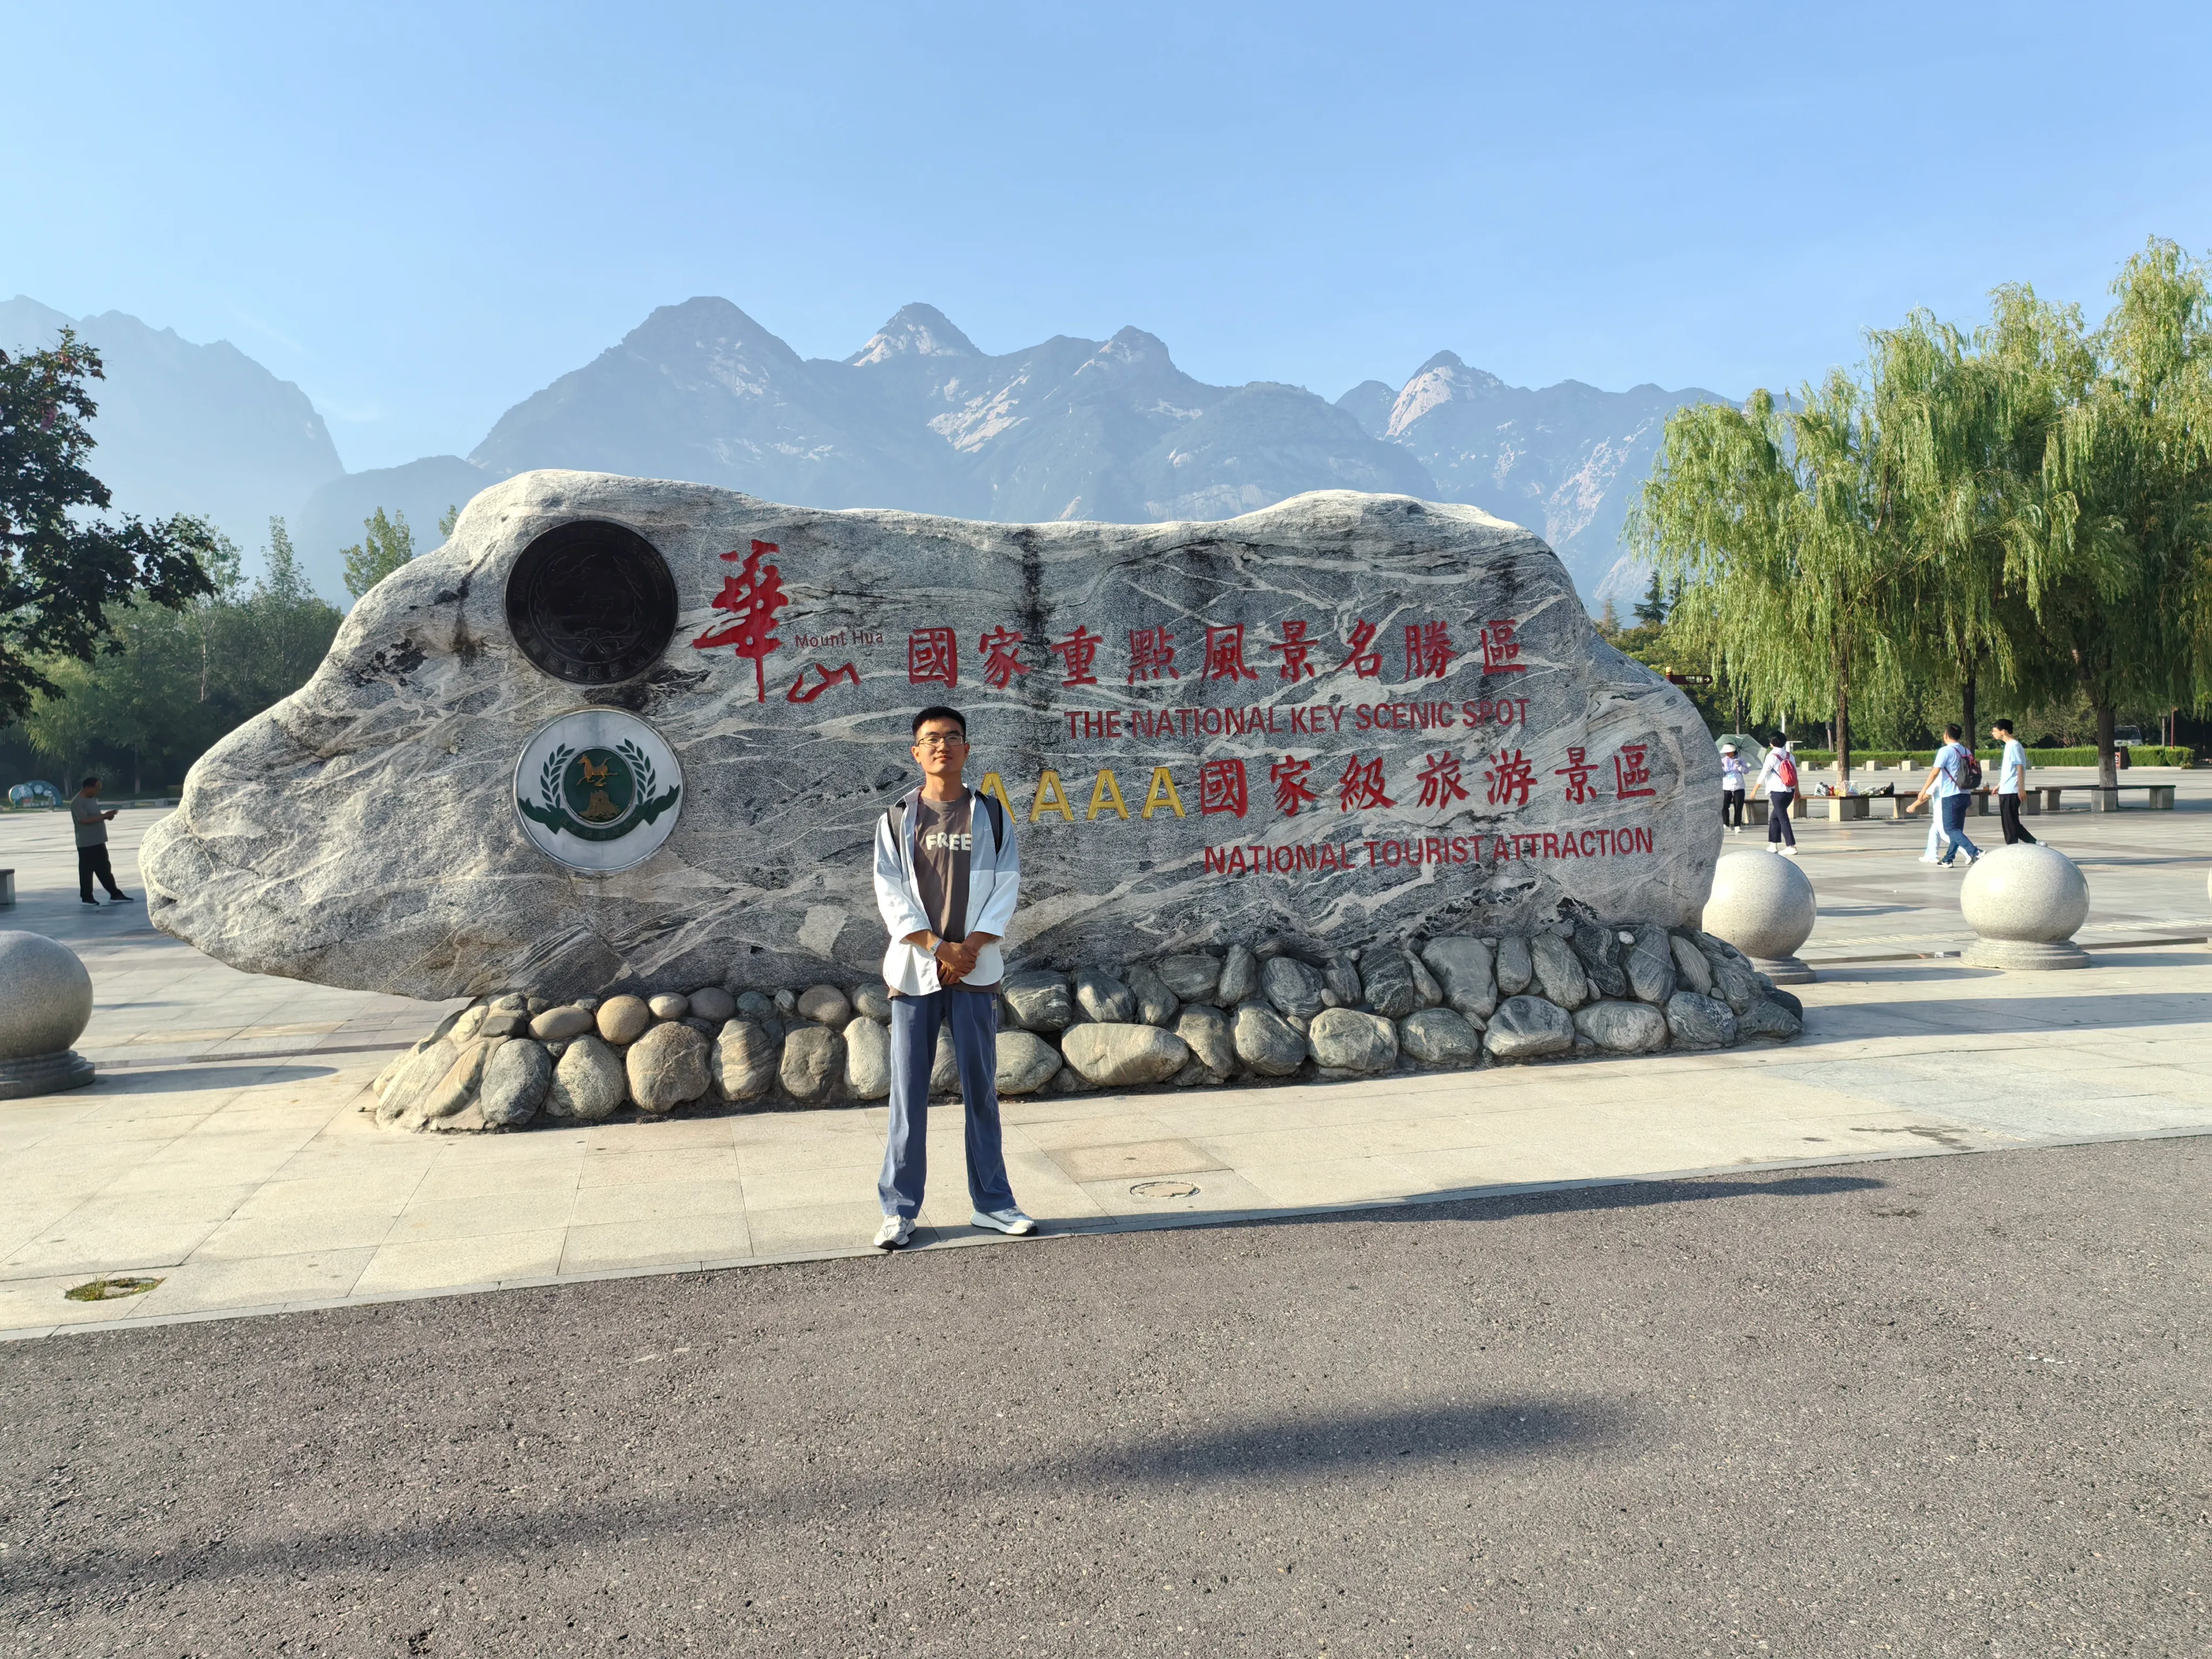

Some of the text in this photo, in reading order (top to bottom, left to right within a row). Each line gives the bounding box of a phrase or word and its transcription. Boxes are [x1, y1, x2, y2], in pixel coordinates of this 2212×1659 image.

[794, 630, 884, 649] Mount Hua
[908, 619, 1527, 691] 國家重點風景名勝區
[1064, 698, 1530, 739] THE NATIONAL KEY SCENIC SPOT
[1204, 827, 1654, 874] NATIONAL TOURIST ATTRACTION
